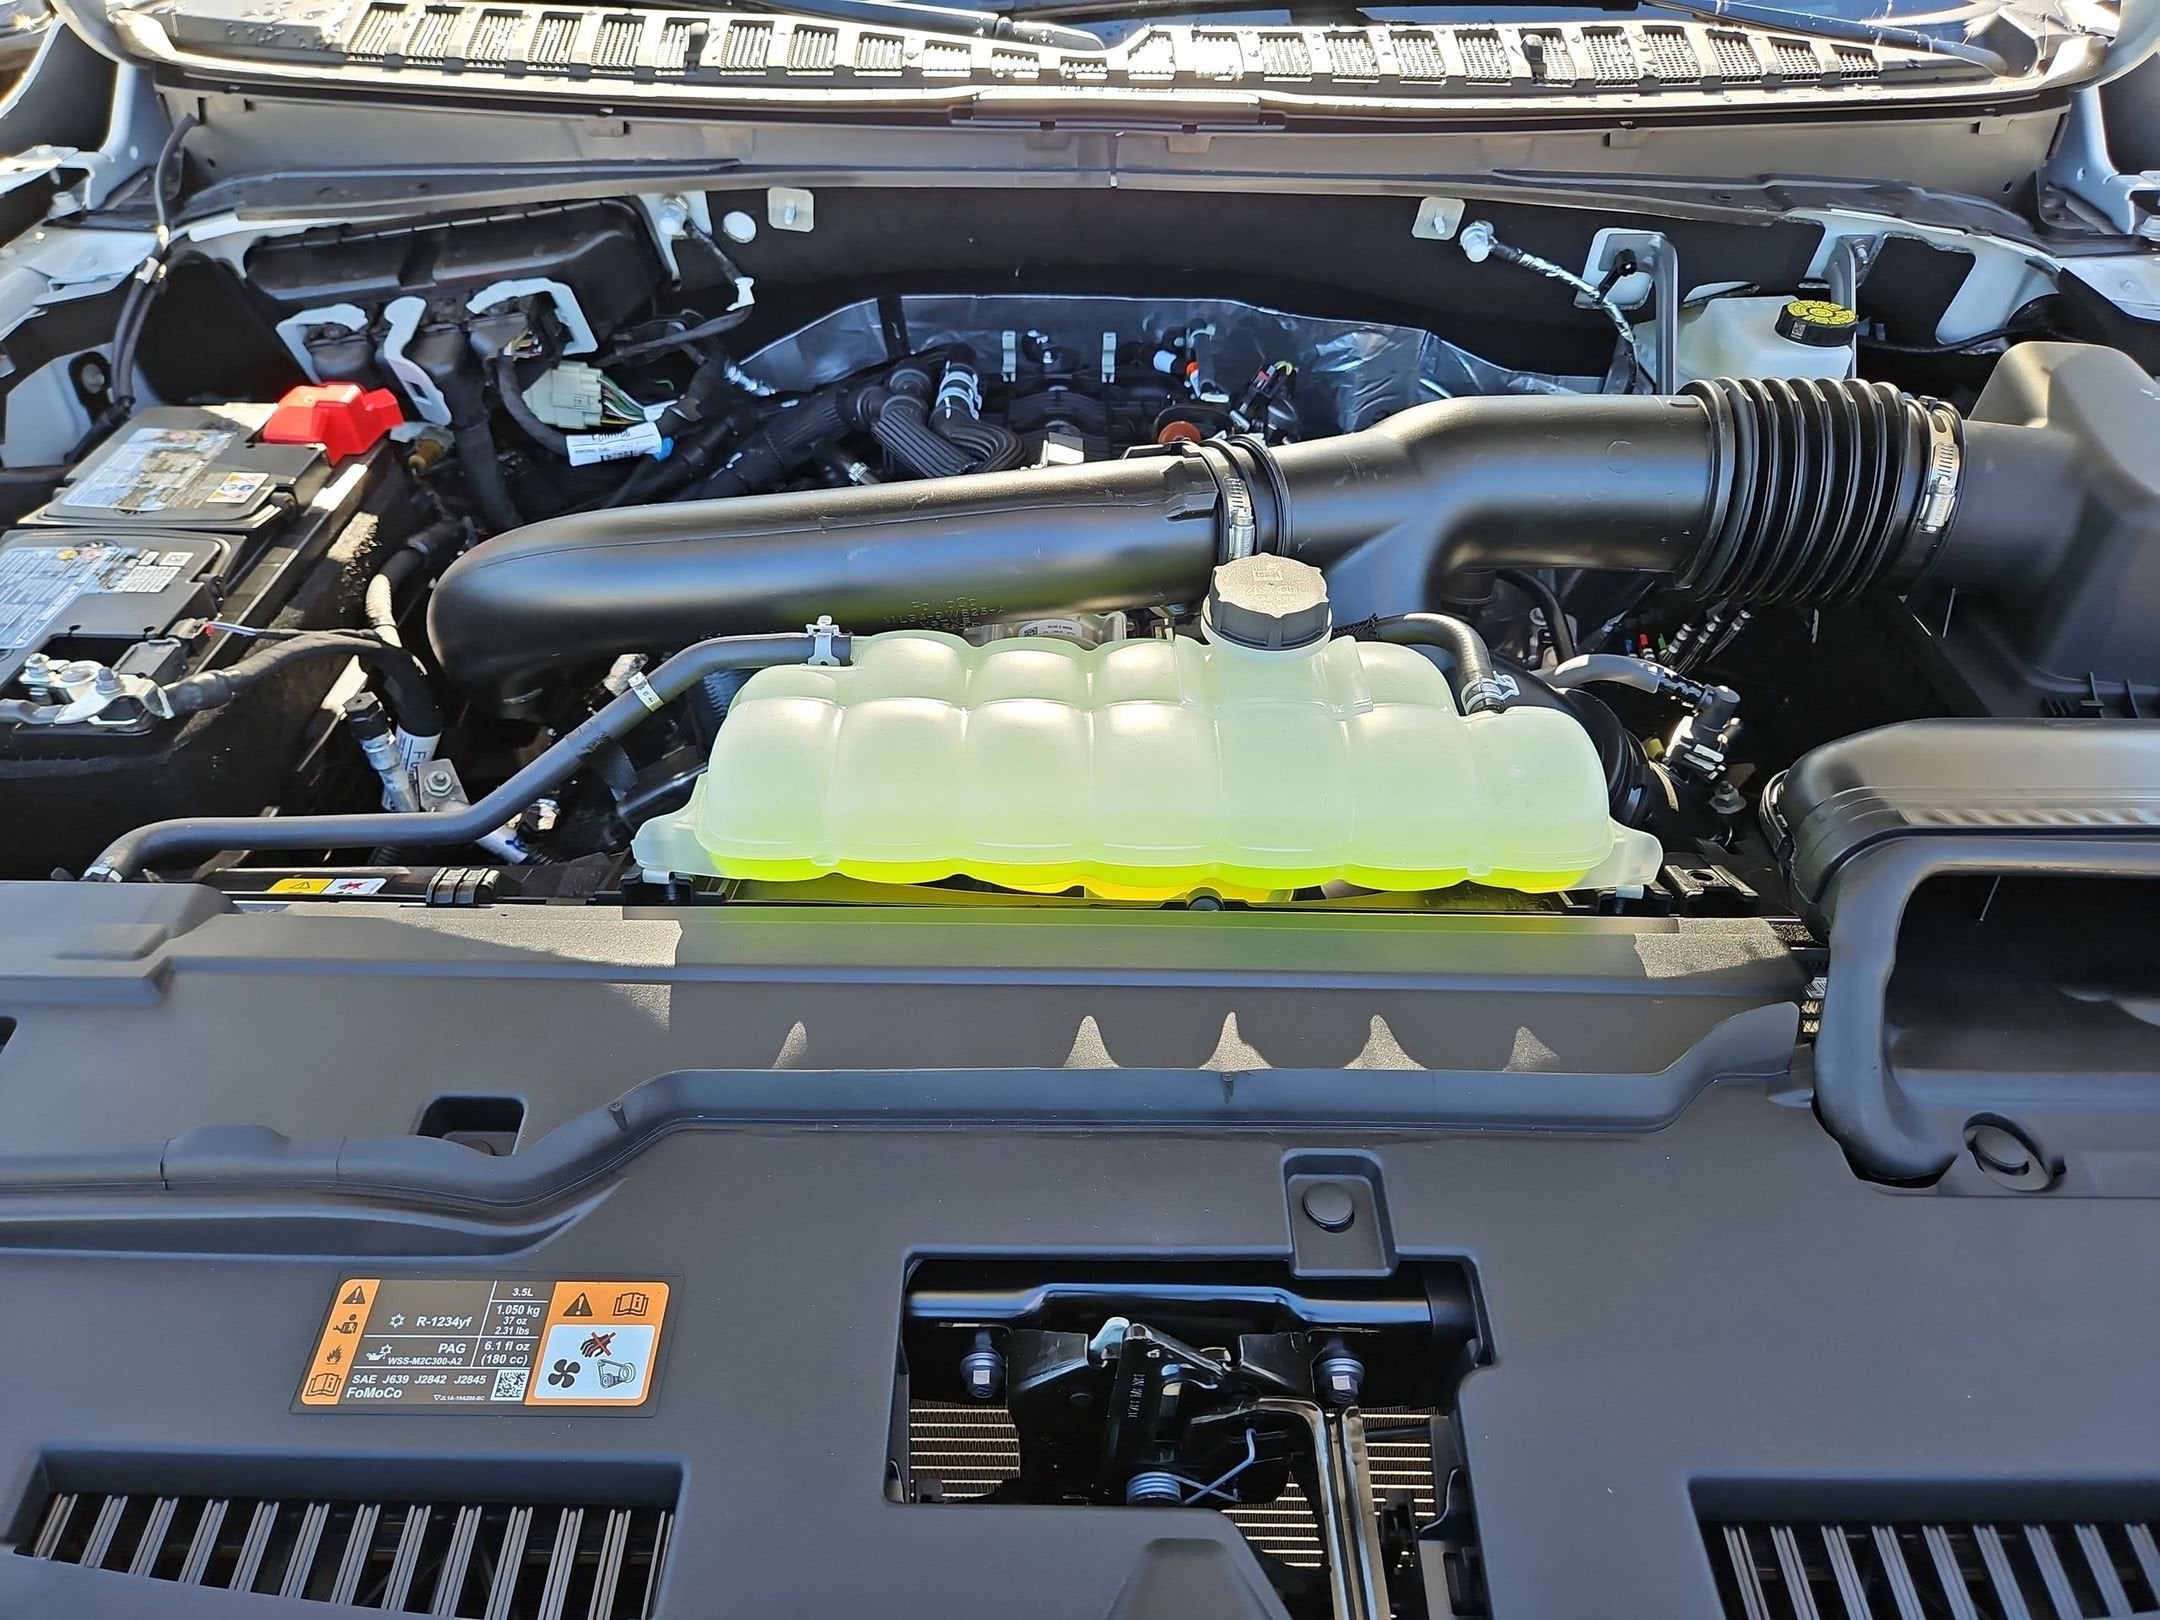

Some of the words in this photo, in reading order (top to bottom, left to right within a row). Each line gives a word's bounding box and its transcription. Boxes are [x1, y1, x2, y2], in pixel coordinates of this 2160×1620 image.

[511, 1287, 534, 1297] 3.5L
[496, 1304, 525, 1315] 1.050
[526, 1304, 541, 1317] kg
[416, 1316, 473, 1329] R-1234yf
[503, 1316, 515, 1325] 37
[516, 1317, 528, 1325] oz
[494, 1326, 513, 1335] 2.31
[515, 1326, 530, 1335] lbs
[437, 1343, 467, 1354] PAG
[484, 1341, 503, 1351] 6.1
[504, 1341, 514, 1351] fl
[515, 1342, 531, 1351] oz
[387, 1357, 463, 1366] WSS-M2C300-A2
[481, 1354, 507, 1366] (180
[509, 1354, 528, 1366] cc)
[352, 1374, 378, 1384] SAE
[382, 1374, 410, 1384] J639
[414, 1374, 448, 1385] J2842
[453, 1375, 487, 1385] J2845
[346, 1386, 403, 1399] FoMoCo
